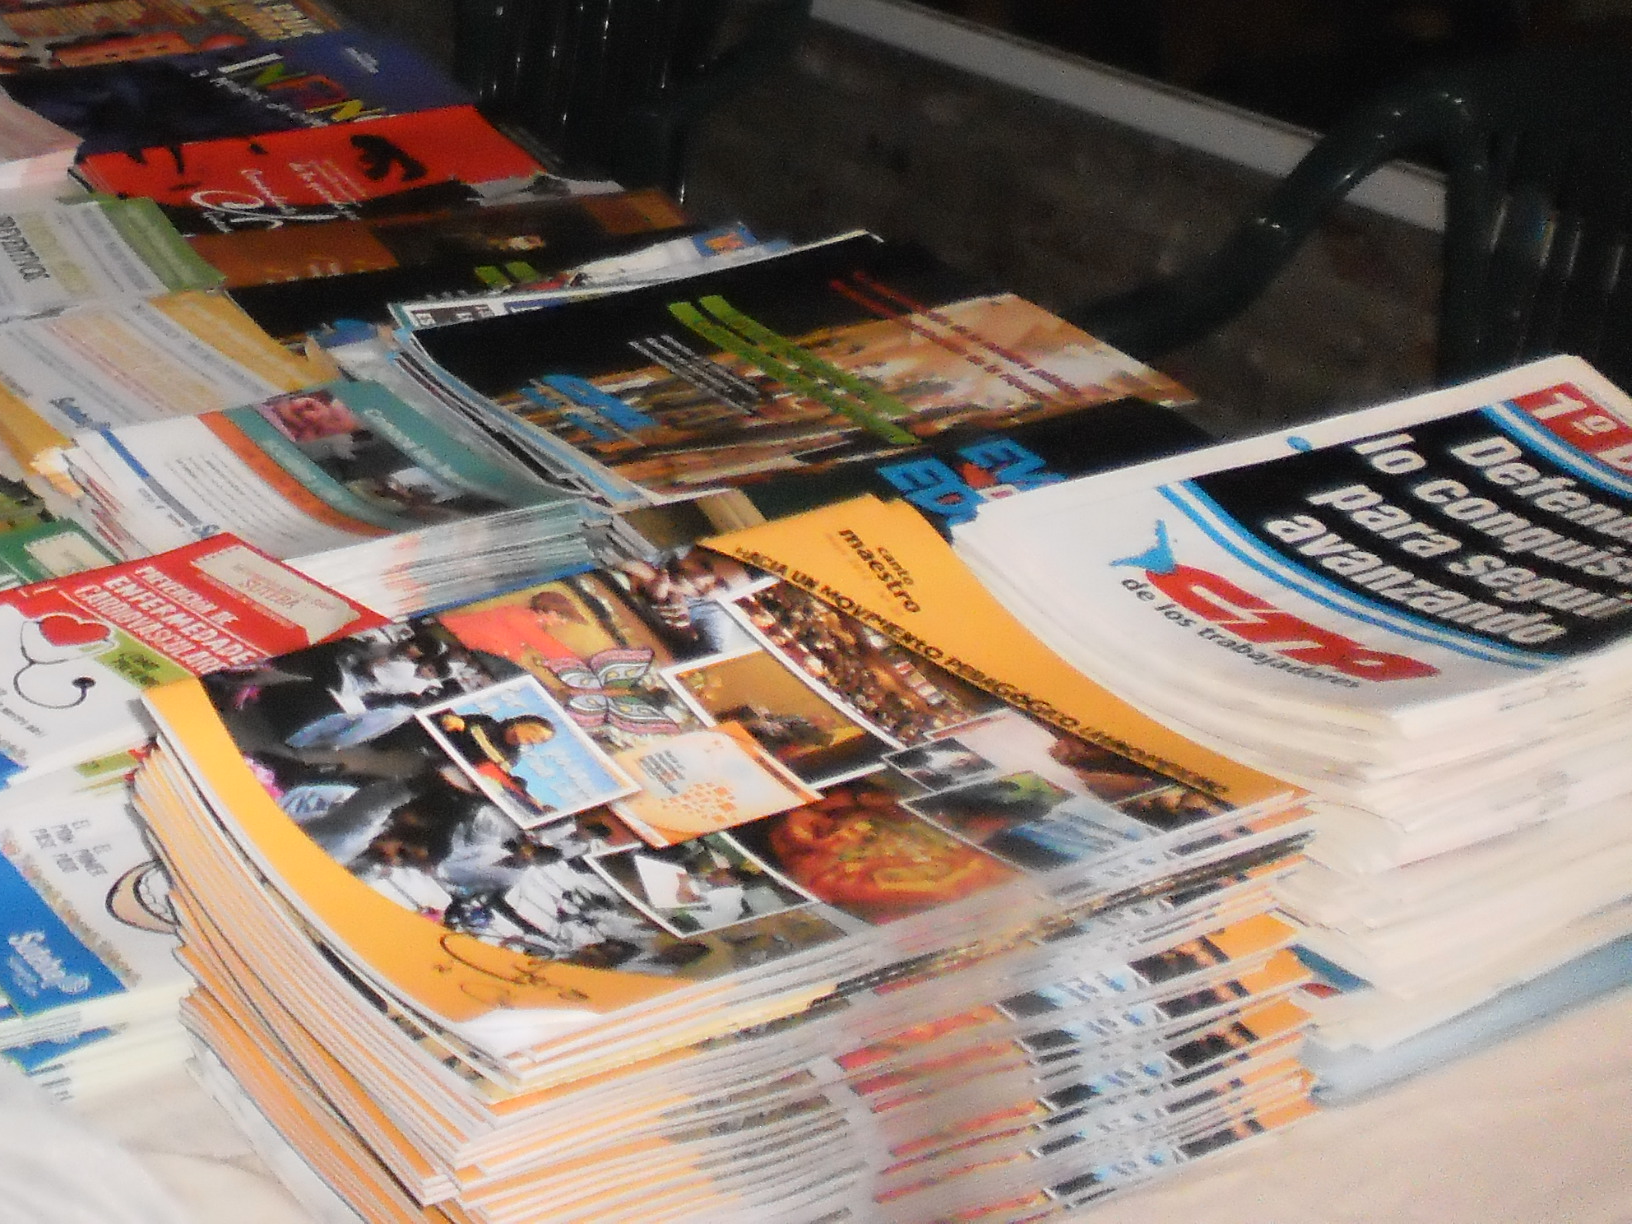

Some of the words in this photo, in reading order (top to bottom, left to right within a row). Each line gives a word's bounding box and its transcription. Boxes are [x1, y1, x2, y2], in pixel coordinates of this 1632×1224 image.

[1306, 484, 1462, 558] para
[1448, 555, 1632, 619] segui
[1353, 433, 1426, 475] lo
[1414, 479, 1632, 584] conquis
[791, 570, 819, 590] UN
[839, 528, 921, 613] maestro
[877, 546, 914, 586] canto
[1266, 515, 1567, 645] avanzando
[103, 576, 259, 666] ENFERMEDADE
[1120, 577, 1156, 603] de
[1155, 602, 1198, 629] los
[1197, 626, 1362, 688] trabajadores
